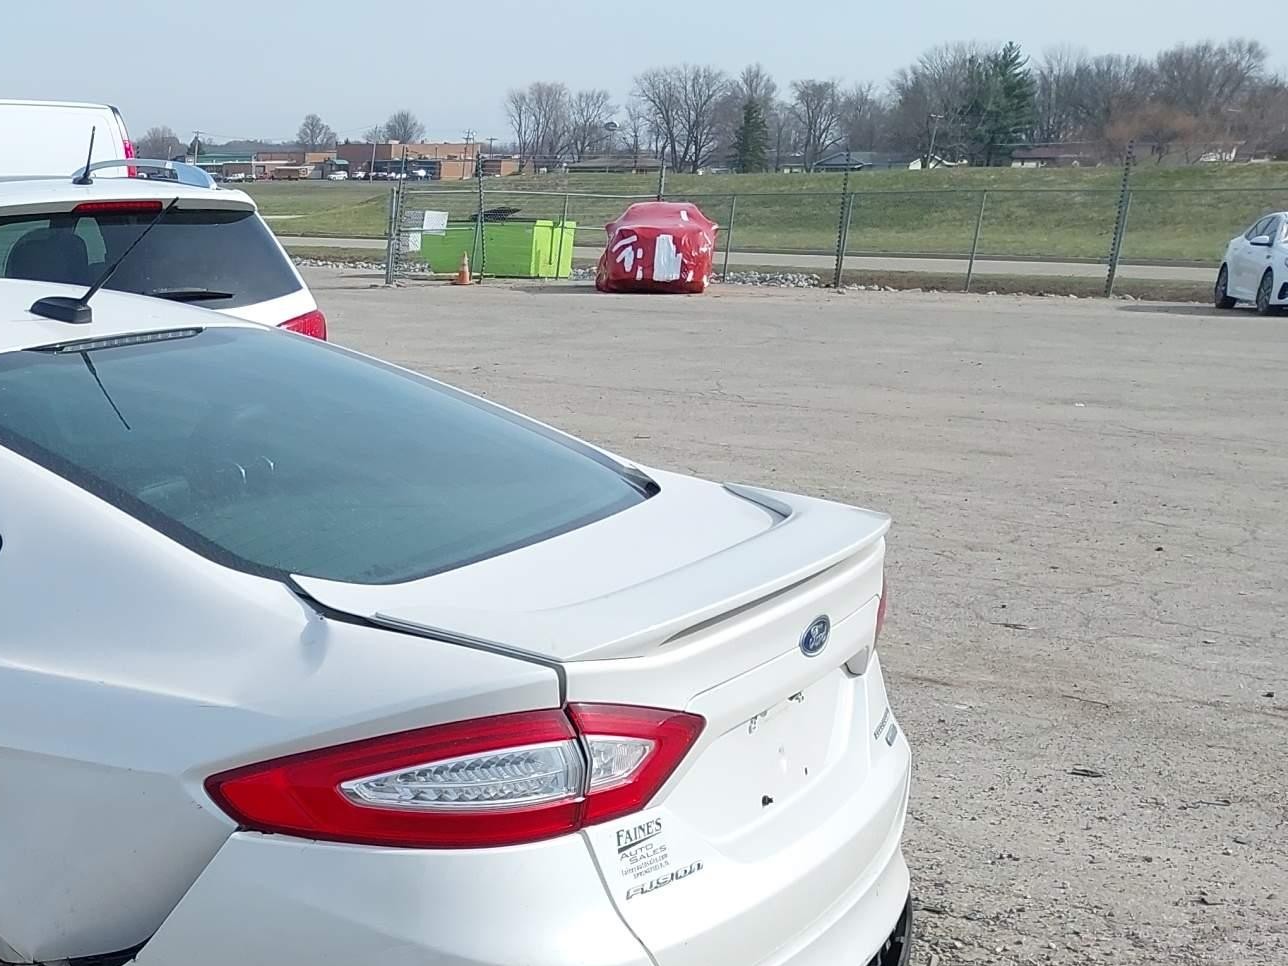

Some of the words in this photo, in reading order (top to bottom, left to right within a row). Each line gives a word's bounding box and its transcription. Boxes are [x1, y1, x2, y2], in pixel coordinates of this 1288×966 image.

[616, 818, 662, 846] FAINE'S
[620, 843, 653, 861] AUTO
[629, 844, 667, 864] SALES
